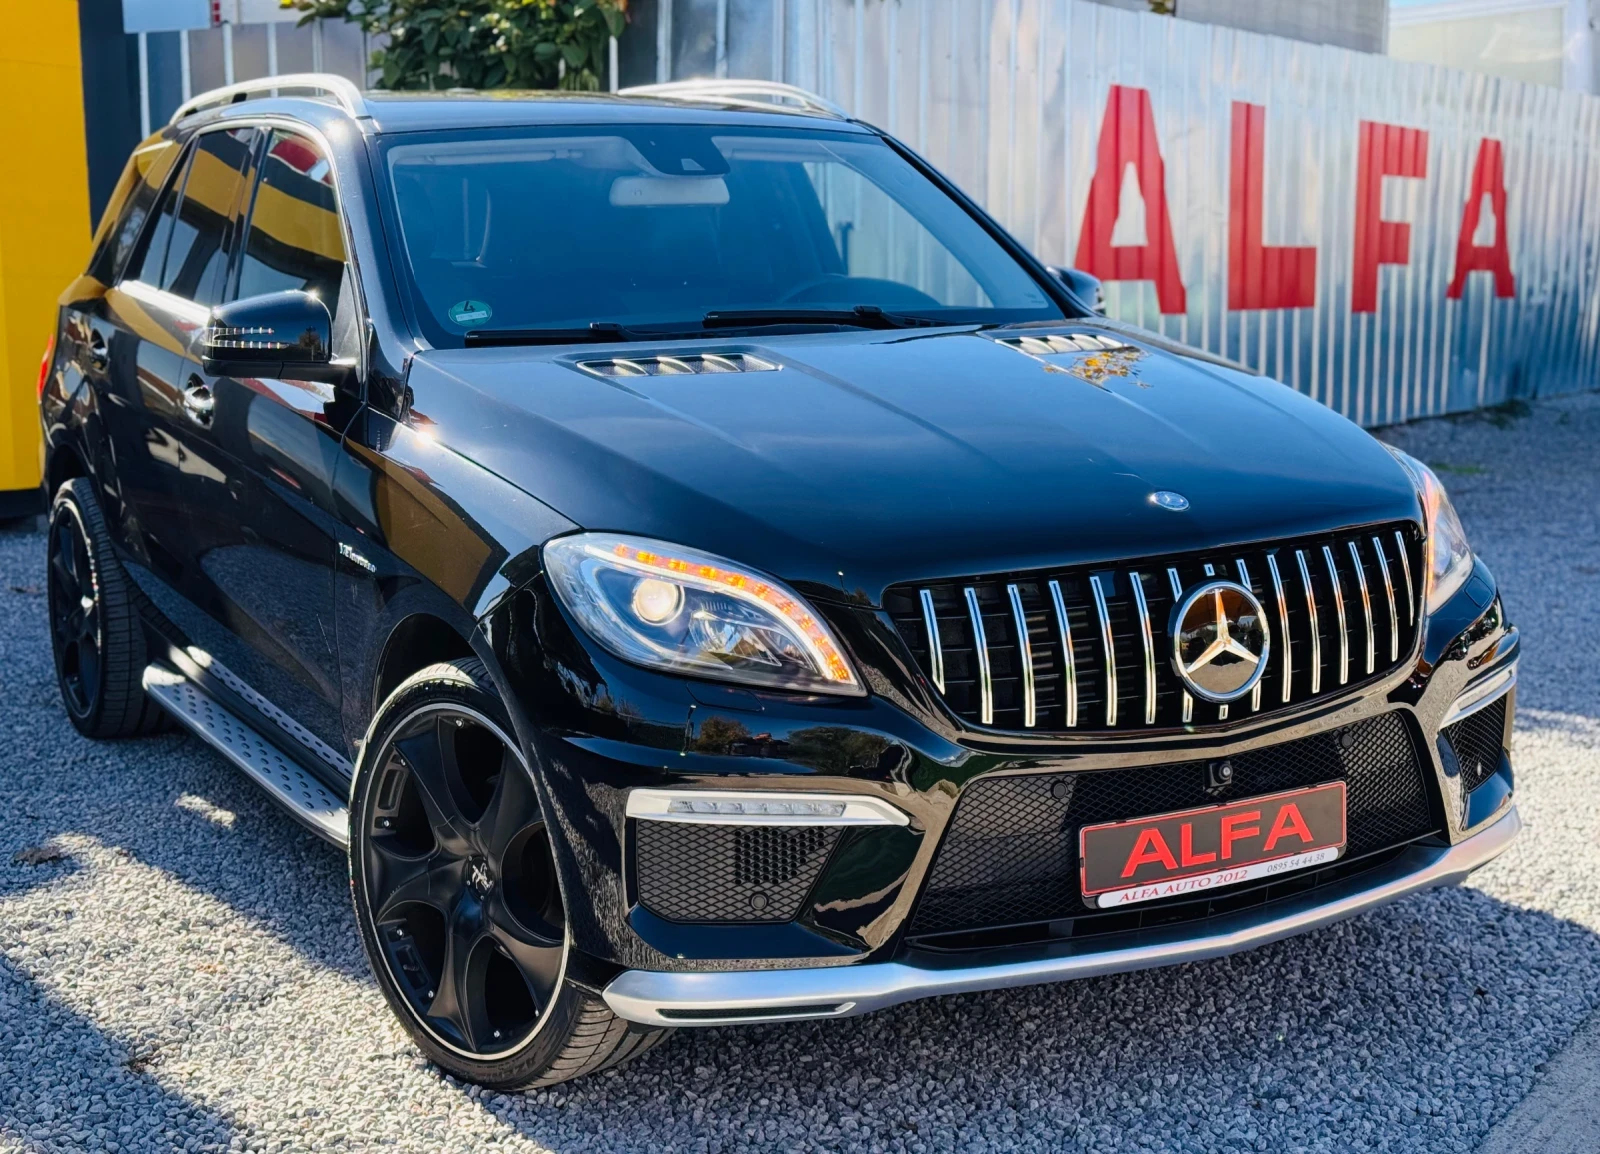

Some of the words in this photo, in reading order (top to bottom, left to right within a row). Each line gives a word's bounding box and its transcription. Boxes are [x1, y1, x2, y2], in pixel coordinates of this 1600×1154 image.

[1074, 84, 1515, 315] ALFA
[463, 300, 476, 312] 4
[1120, 803, 1314, 878] ALFA
[1118, 887, 1160, 903] ALFA
[1163, 877, 1212, 895] AUTO
[1215, 869, 1249, 884] 2012
[1266, 860, 1289, 873] 0895
[1288, 858, 1301, 869] 54
[1301, 855, 1313, 866] 44
[1314, 852, 1325, 863] 38
